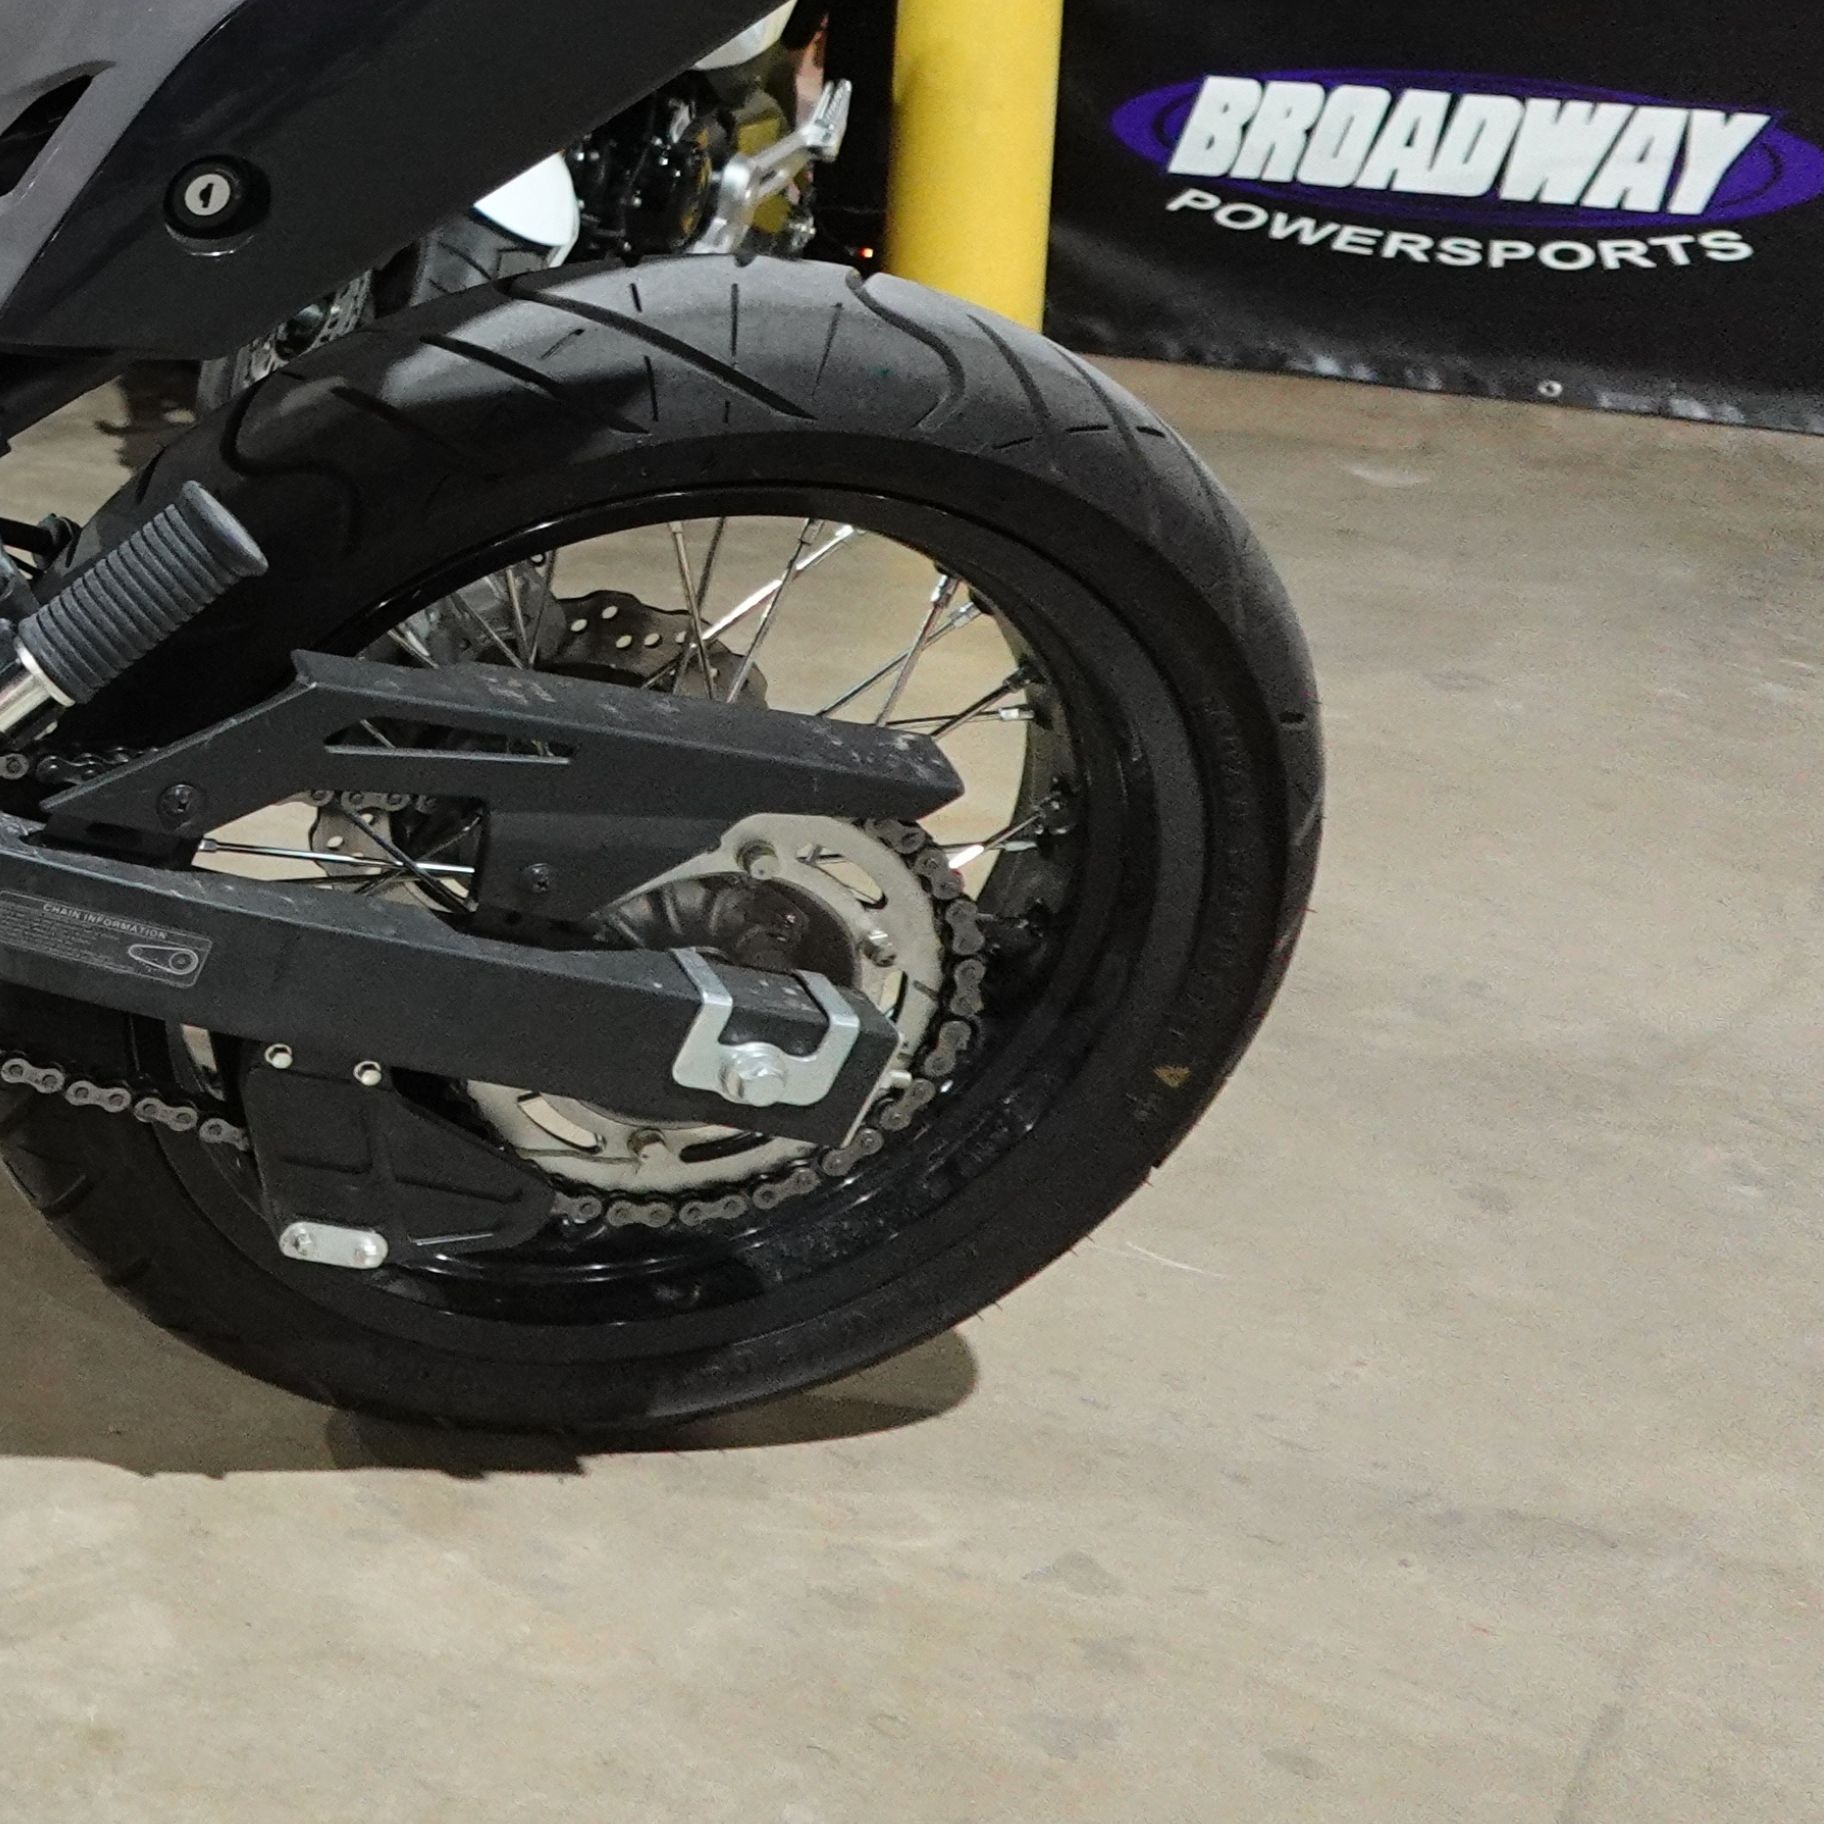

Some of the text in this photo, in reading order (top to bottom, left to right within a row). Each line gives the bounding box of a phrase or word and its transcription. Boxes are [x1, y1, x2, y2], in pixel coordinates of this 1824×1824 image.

[1166, 75, 1770, 215] BROADWAY
[1166, 188, 1753, 271] POWERSPORTS
[42, 903, 168, 940] CHAIN INFORMATION
